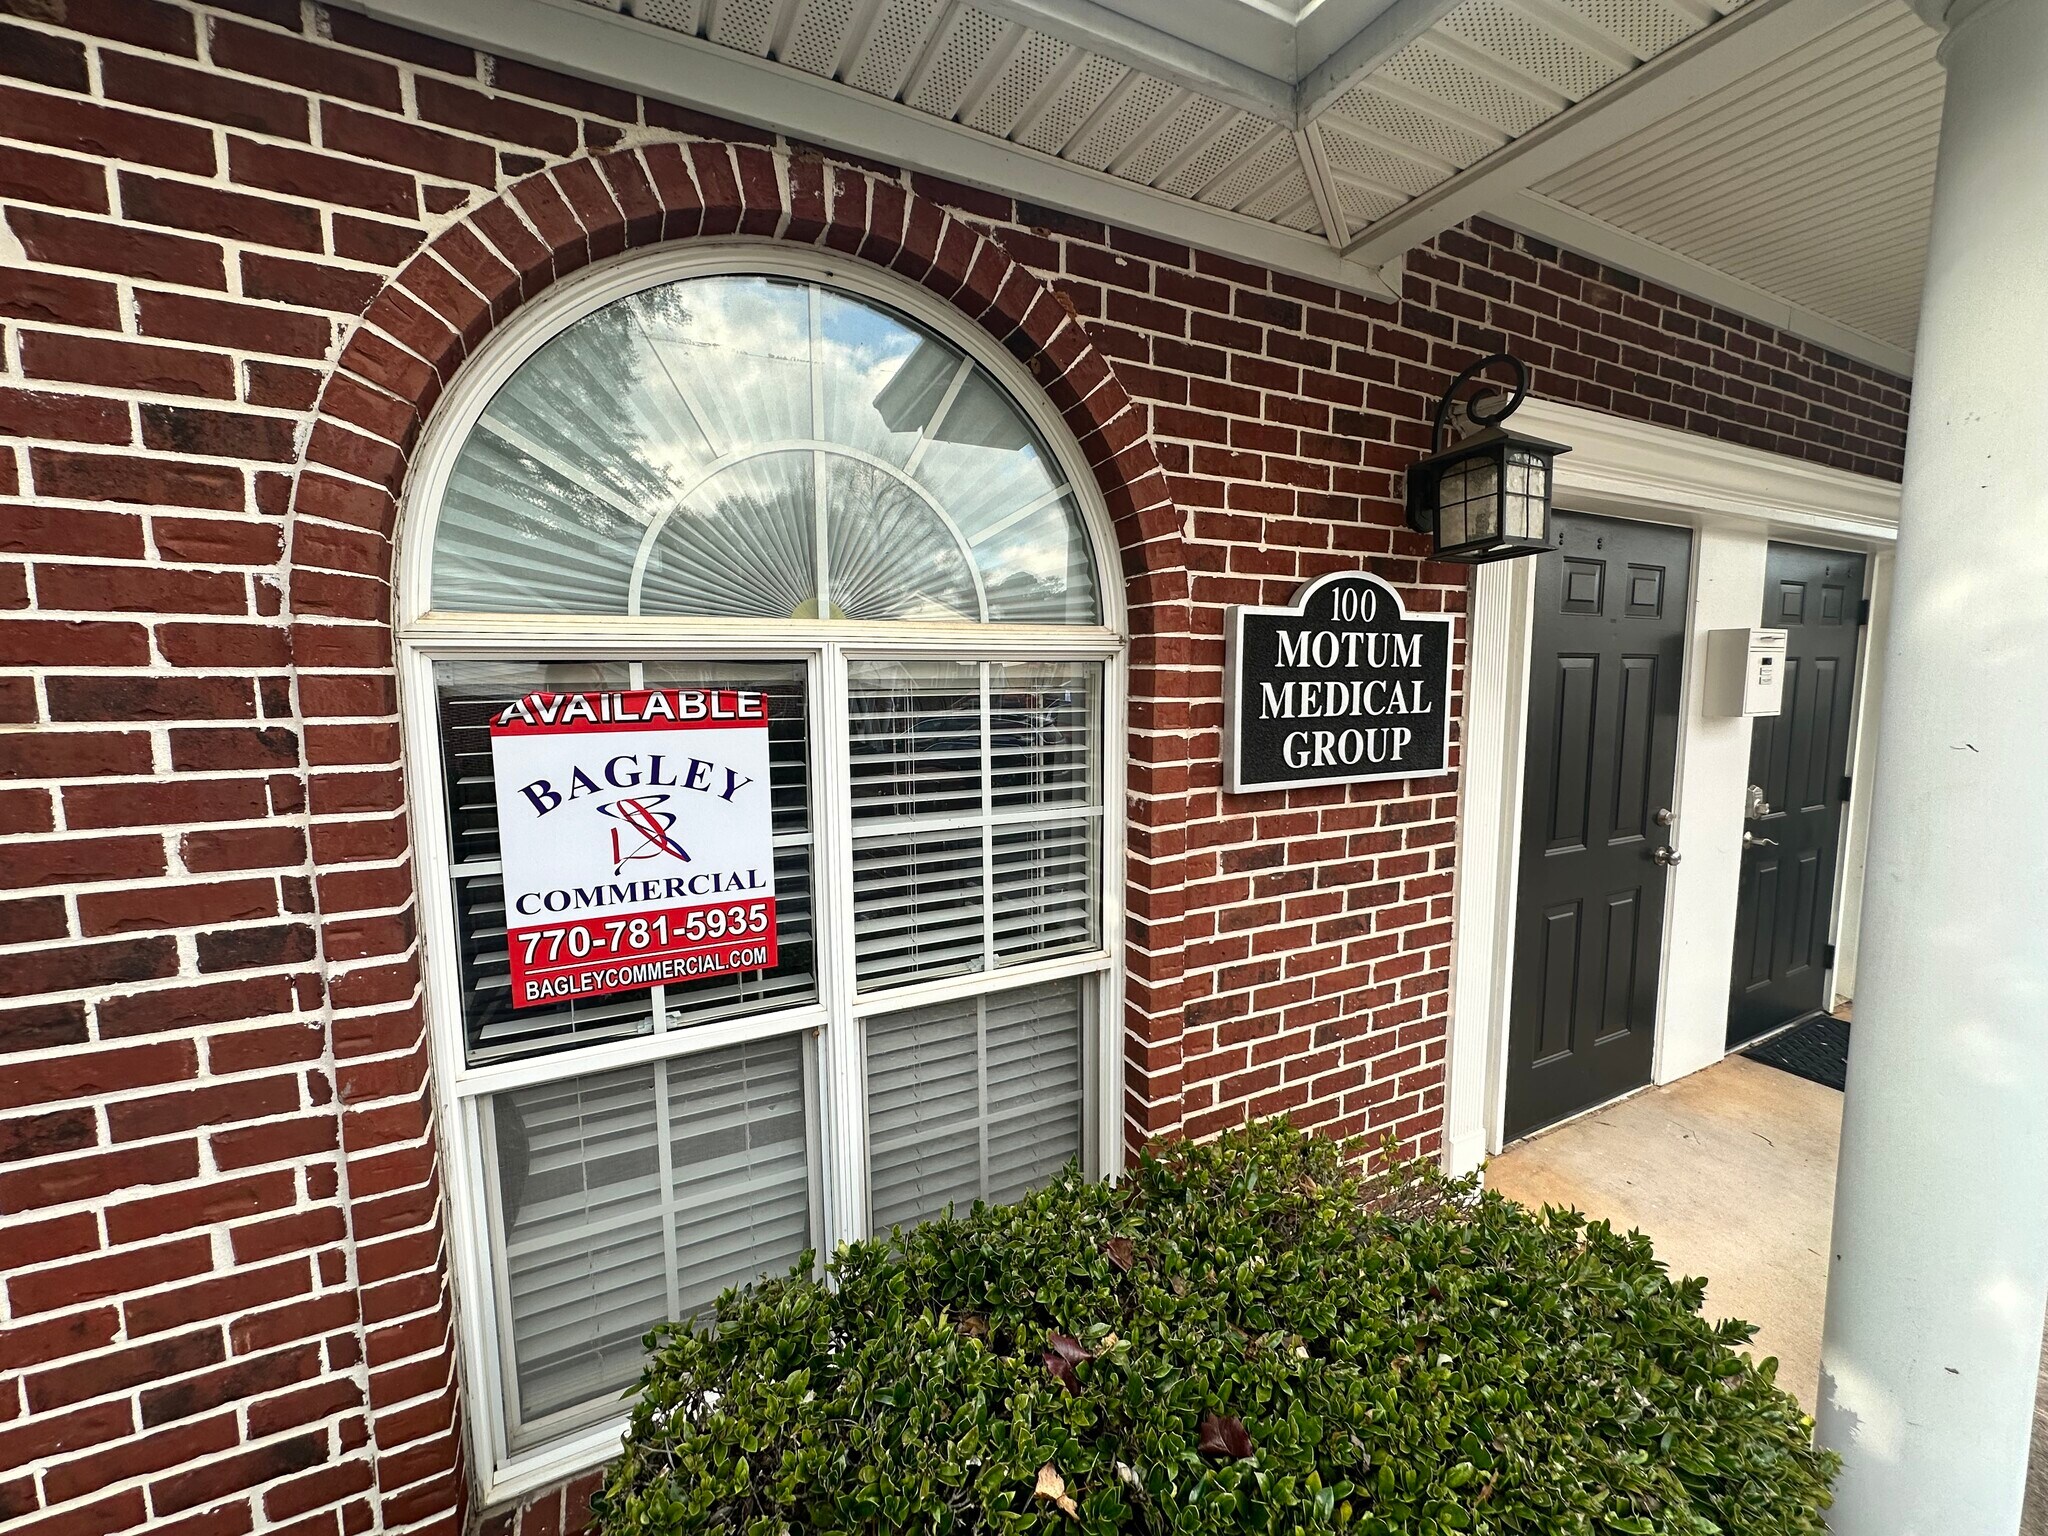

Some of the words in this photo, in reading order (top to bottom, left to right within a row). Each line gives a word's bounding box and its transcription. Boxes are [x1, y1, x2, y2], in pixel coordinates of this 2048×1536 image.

[1331, 587, 1377, 622] 100
[1274, 630, 1423, 668] MOTUM
[498, 690, 764, 726] AVAILABLE
[1259, 680, 1432, 719] MEDICAL
[1283, 727, 1412, 769] GROUP
[518, 754, 754, 818] BAGLEY
[515, 869, 767, 916] COMMERCIAL
[517, 904, 769, 965] 770-781-5935
[525, 947, 768, 1001] BAGLEYCOMMERCIAL.COM
